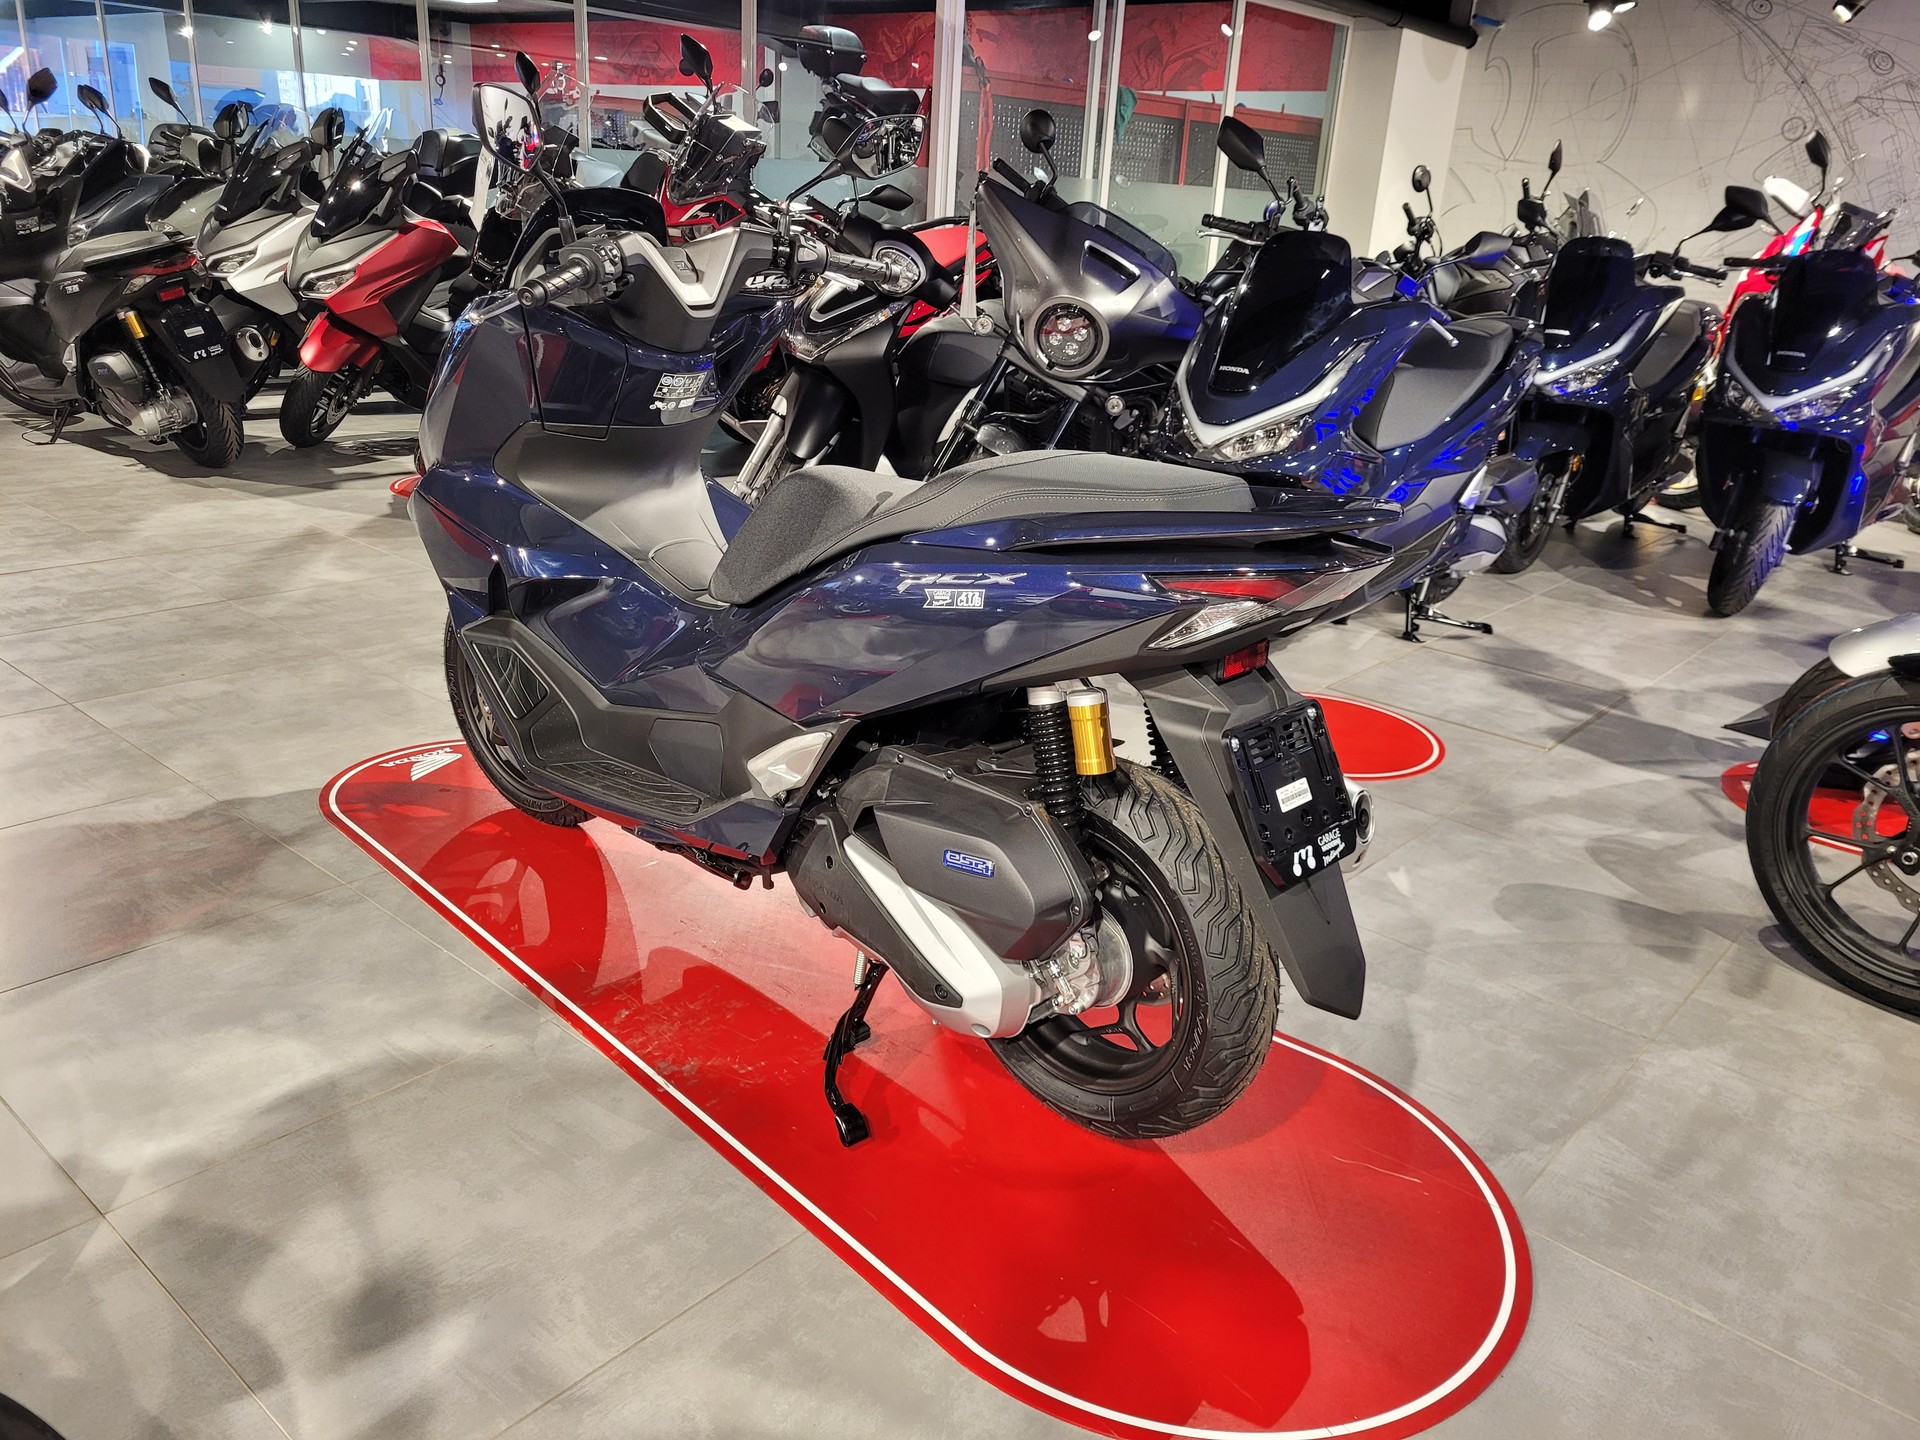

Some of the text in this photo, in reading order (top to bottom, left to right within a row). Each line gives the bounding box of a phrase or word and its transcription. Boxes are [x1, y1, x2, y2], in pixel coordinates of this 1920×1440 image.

[1218, 365, 1251, 375] HONDA
[896, 572, 1028, 594] PCX
[378, 748, 454, 767] HONDA
[1317, 828, 1341, 845] GARAGE
